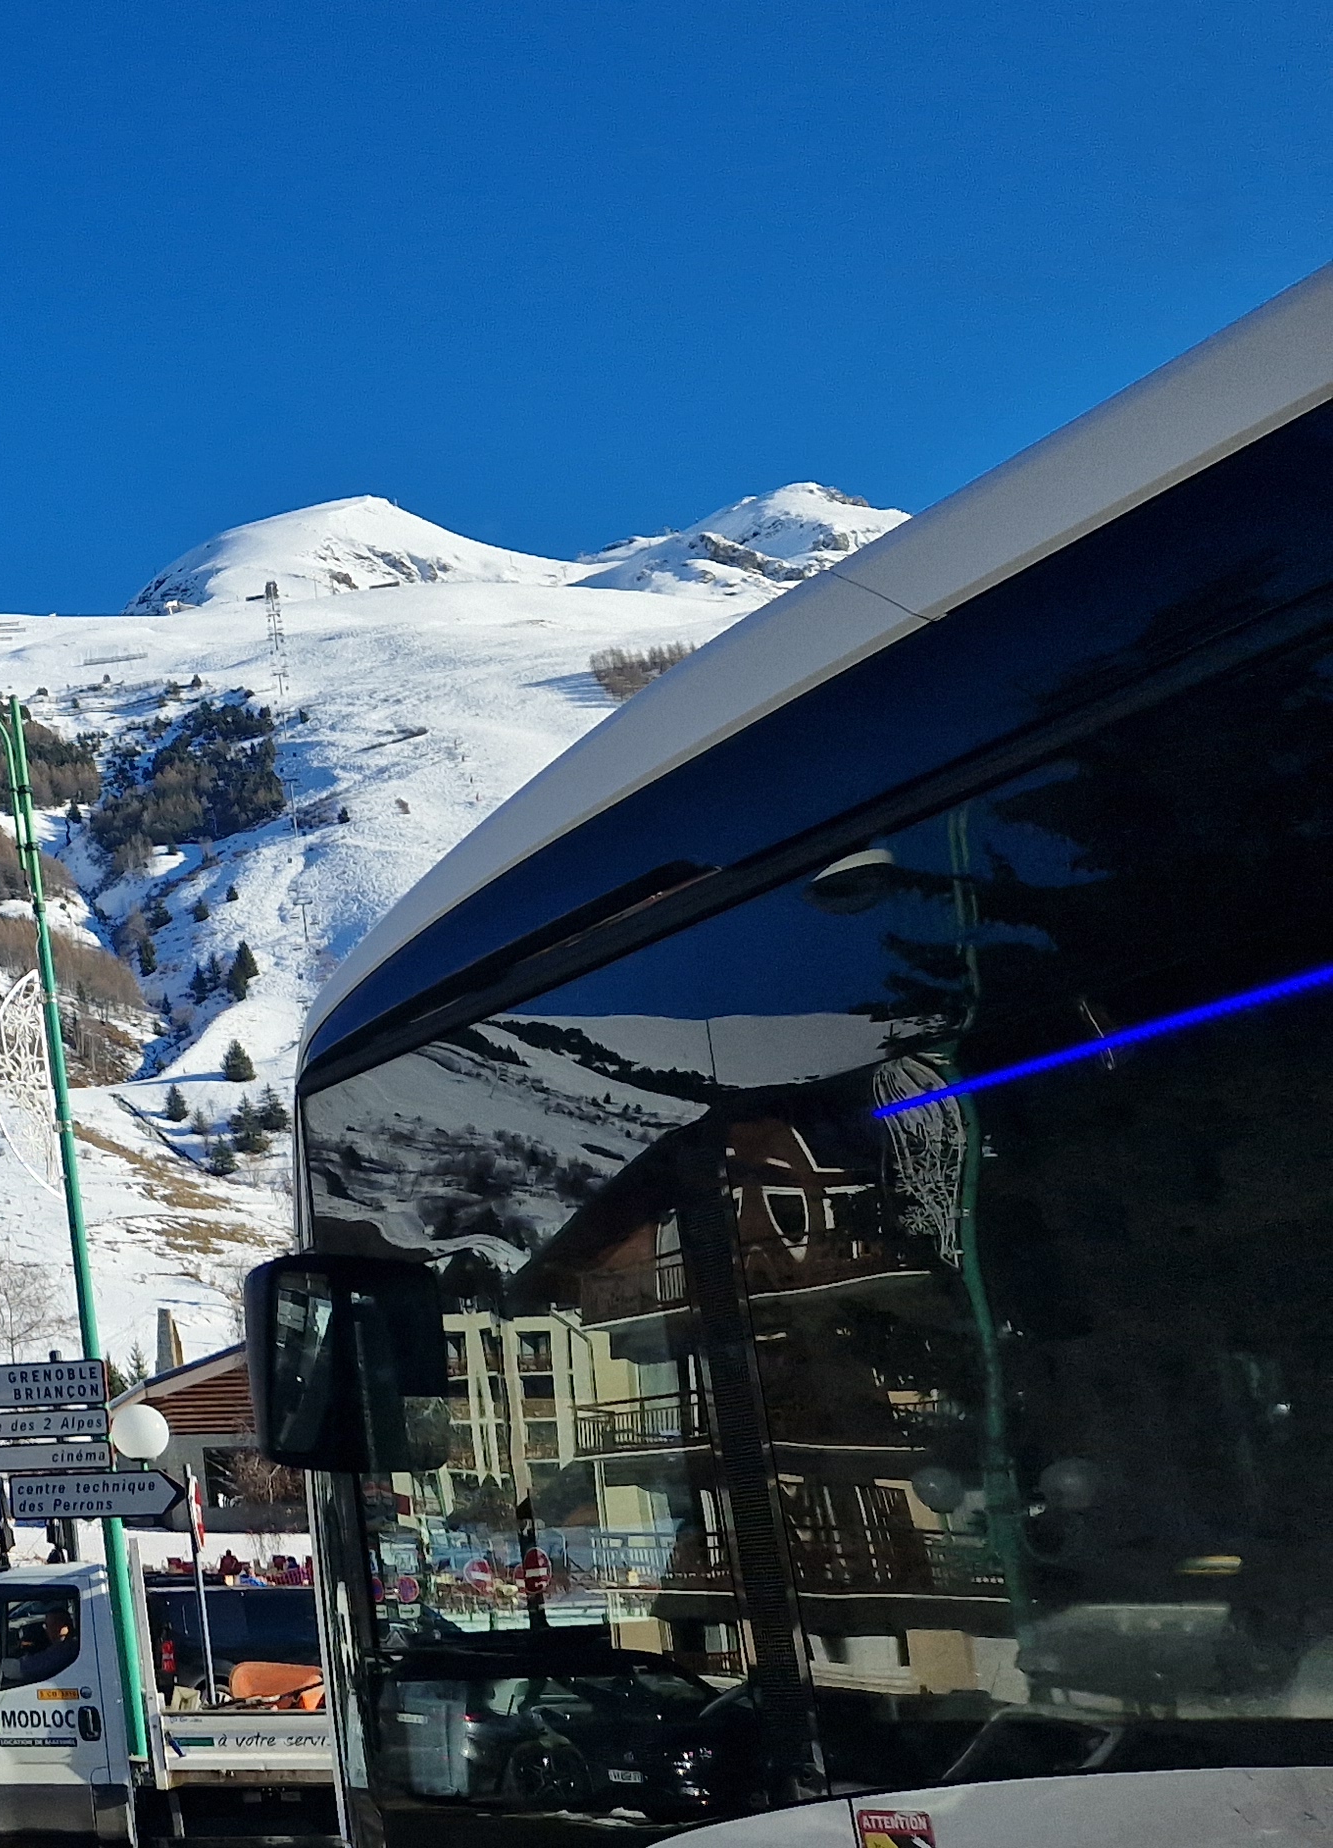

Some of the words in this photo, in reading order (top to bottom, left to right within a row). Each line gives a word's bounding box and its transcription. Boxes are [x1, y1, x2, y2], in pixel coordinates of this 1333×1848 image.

[8, 1366, 98, 1384] GRENOBLE
[13, 1383, 100, 1400] BRIANÇON
[10, 1418, 35, 1432] des
[43, 1417, 51, 1430] 2
[60, 1416, 103, 1432] Alpes
[51, 1448, 106, 1463] cinéma
[17, 1479, 66, 1495] centre
[76, 1478, 156, 1498] technique
[19, 1499, 44, 1513] des
[53, 1498, 113, 1512] Perrons
[1, 1710, 76, 1728] MODLOC
[217, 1733, 227, 1747] à
[235, 1732, 276, 1747] votre
[283, 1735, 331, 1748] servi
[862, 1815, 927, 1831] ATTENTION
